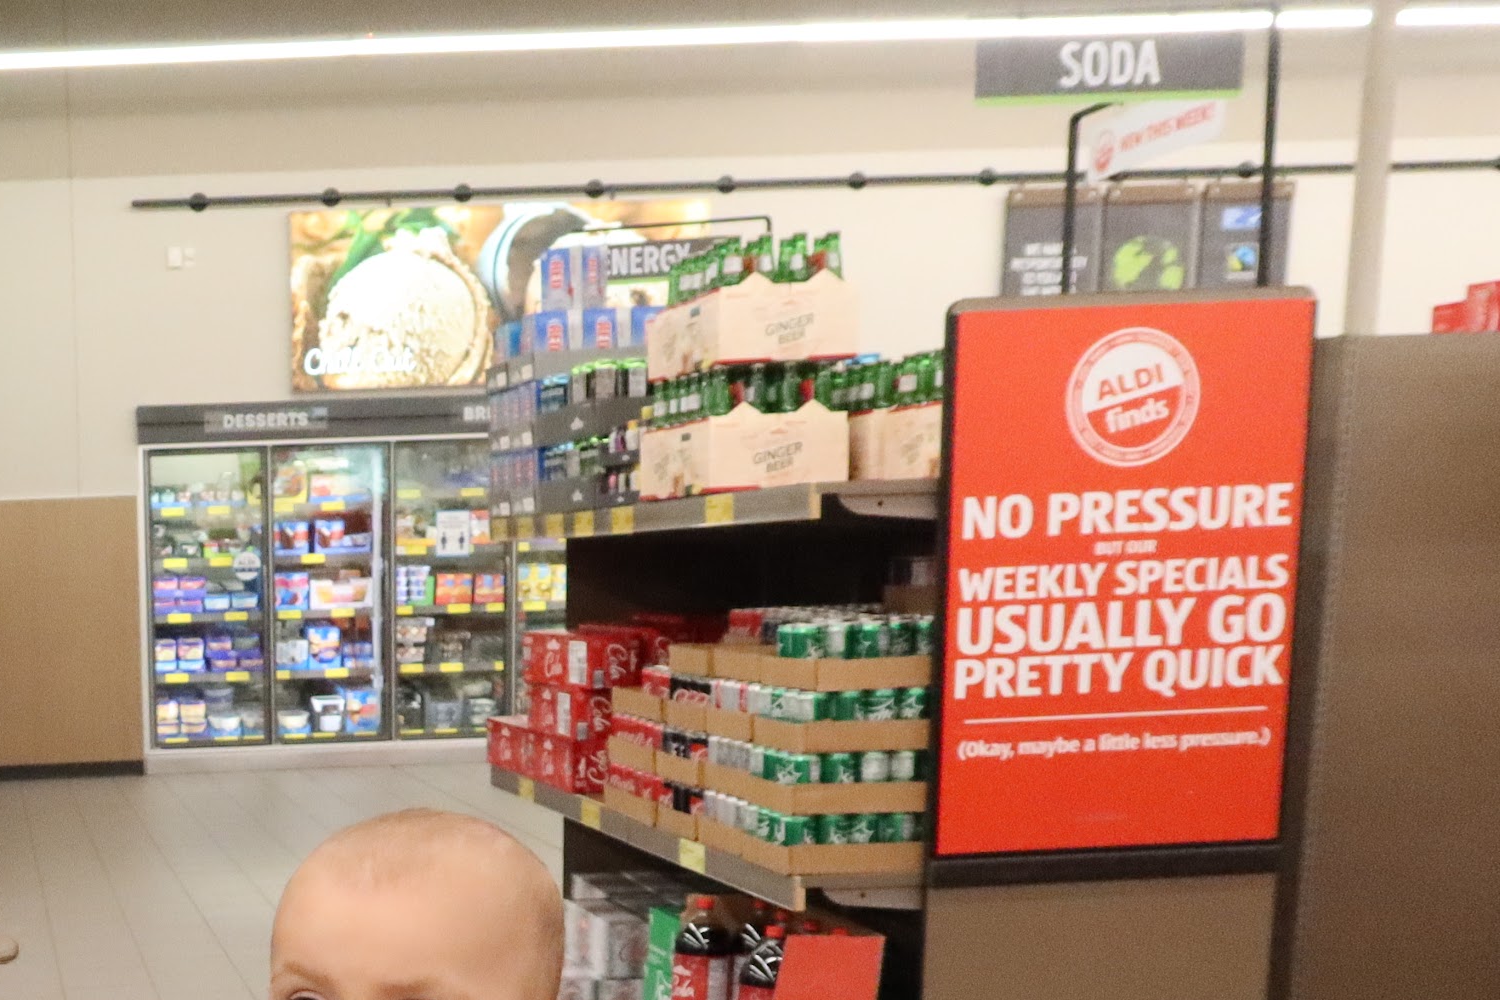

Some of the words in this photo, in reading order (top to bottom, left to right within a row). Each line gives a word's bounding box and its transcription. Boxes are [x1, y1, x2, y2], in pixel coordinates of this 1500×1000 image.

[1058, 39, 1162, 88] SODA
[1097, 363, 1165, 401] ALDI
[222, 411, 309, 429] DESSERTS
[1105, 397, 1171, 434] finds
[961, 493, 1034, 540] NO
[1047, 482, 1294, 537] PRESSURE
[958, 562, 1108, 601] WEEKLY
[1113, 554, 1289, 595] SPECIALS
[956, 597, 1197, 655] USUALLY
[1208, 593, 1287, 644] GO
[953, 652, 1134, 699] PRETTY
[1143, 644, 1284, 697] QUICK
[957, 739, 1015, 761] (Okay,
[1016, 736, 1081, 758] maybe
[1082, 738, 1097, 752] a
[1098, 732, 1140, 751] little
[1143, 731, 1177, 749] less
[1179, 726, 1272, 752] pressure.)
